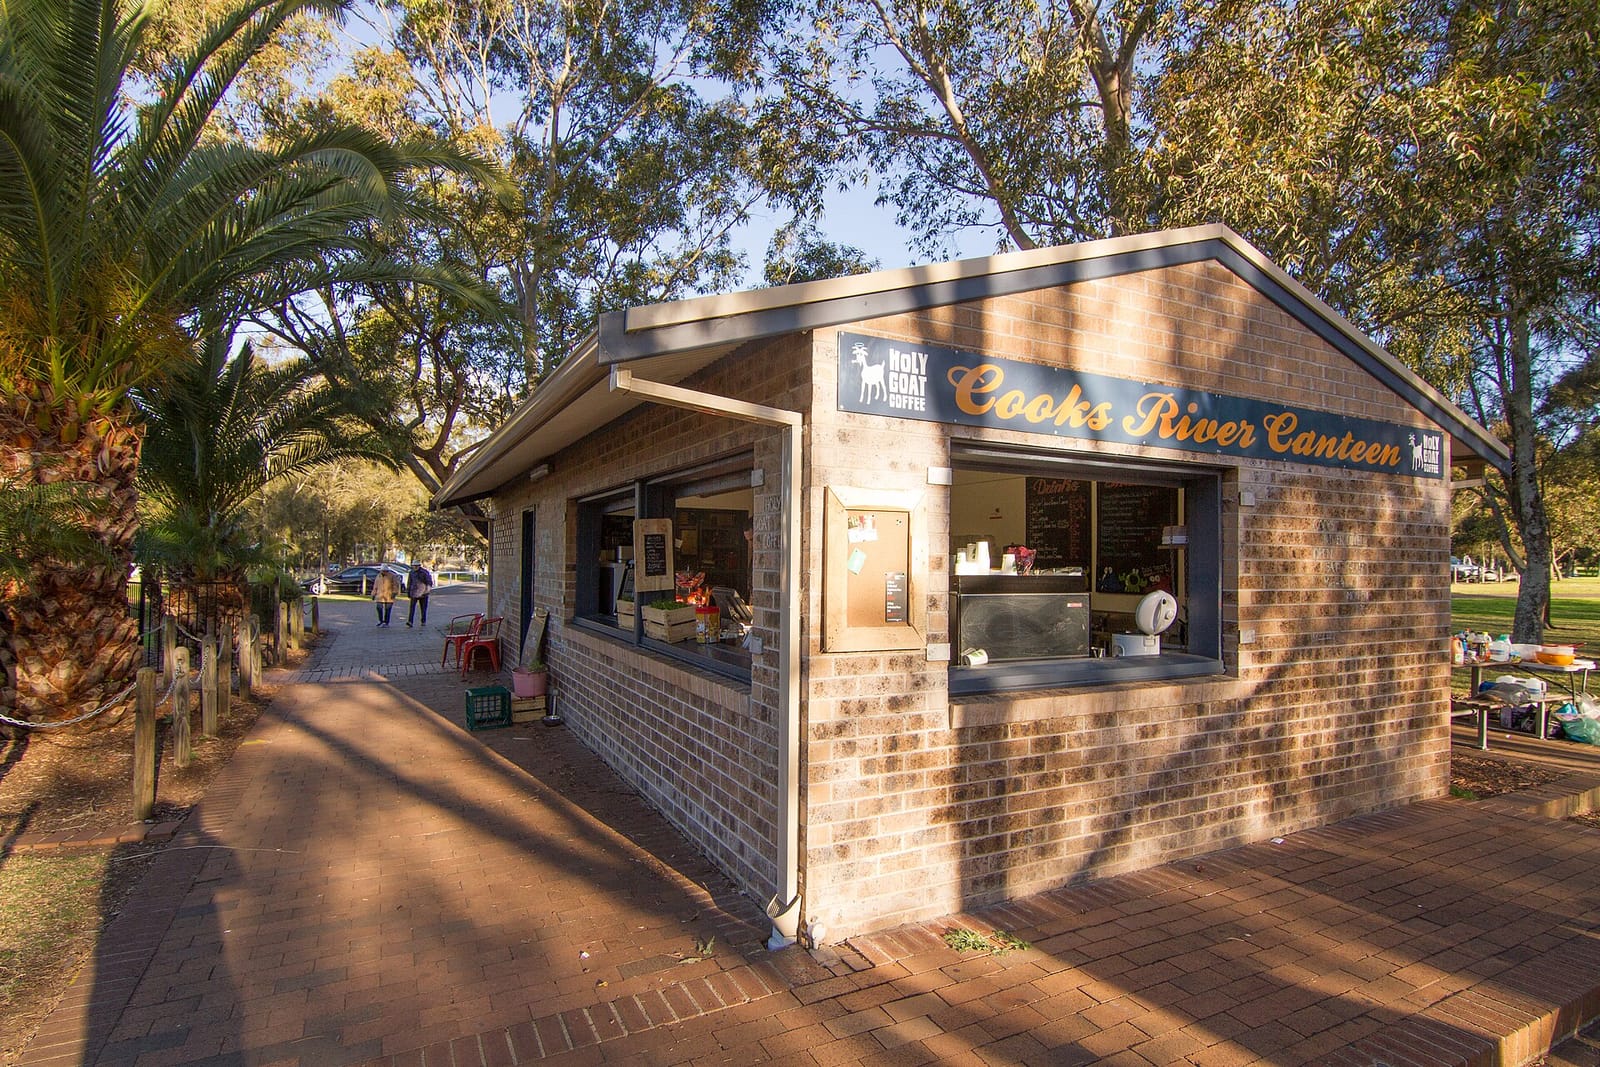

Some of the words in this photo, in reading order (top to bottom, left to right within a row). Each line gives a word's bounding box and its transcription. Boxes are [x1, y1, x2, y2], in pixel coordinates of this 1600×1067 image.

[889, 348, 929, 375] HOLY
[889, 371, 927, 397] GOAT
[889, 393, 926, 412] COFFEE
[947, 364, 1113, 431] Cooks
[1122, 392, 1257, 449] River
[1263, 412, 1402, 467] Canteen
[1423, 434, 1440, 450] HOLY
[1423, 449, 1440, 465] GOAT
